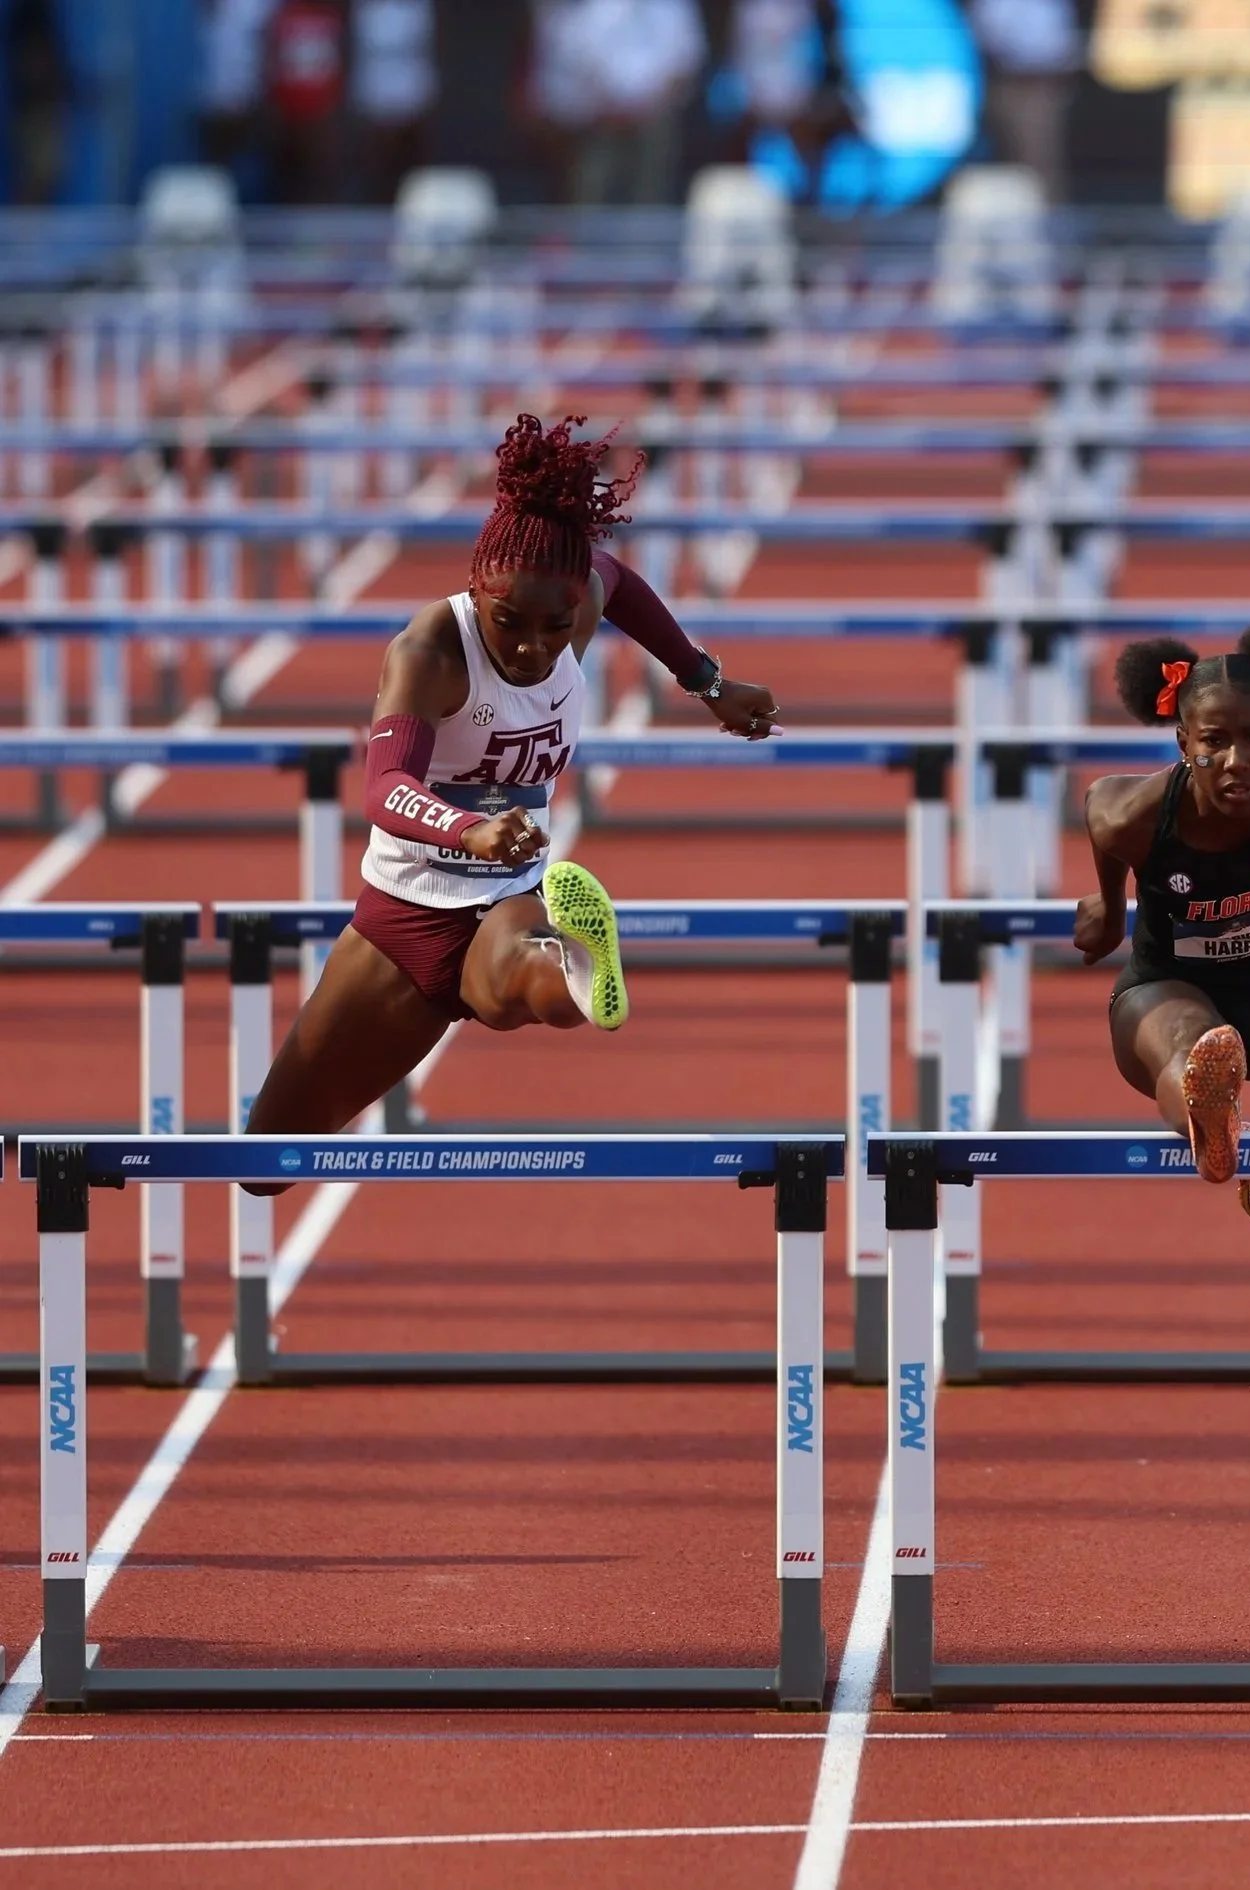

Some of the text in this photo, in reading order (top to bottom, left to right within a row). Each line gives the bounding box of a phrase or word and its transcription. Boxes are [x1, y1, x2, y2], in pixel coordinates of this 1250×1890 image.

[473, 704, 494, 726] SEC
[1168, 873, 1191, 894] SEC
[121, 1155, 151, 1165] GILL
[313, 1151, 586, 1170] TRACK & FIELD CHAMPIONSHIPS
[713, 1154, 743, 1164] GILL
[968, 1152, 998, 1162] GILL
[1160, 1148, 1196, 1167] TRA
[49, 1364, 77, 1454] NCAA
[786, 1363, 815, 1453] NCAA
[899, 1362, 927, 1451] NCAA
[47, 1551, 80, 1563] GILL
[782, 1551, 816, 1562] GILL
[895, 1547, 927, 1558] GILL
